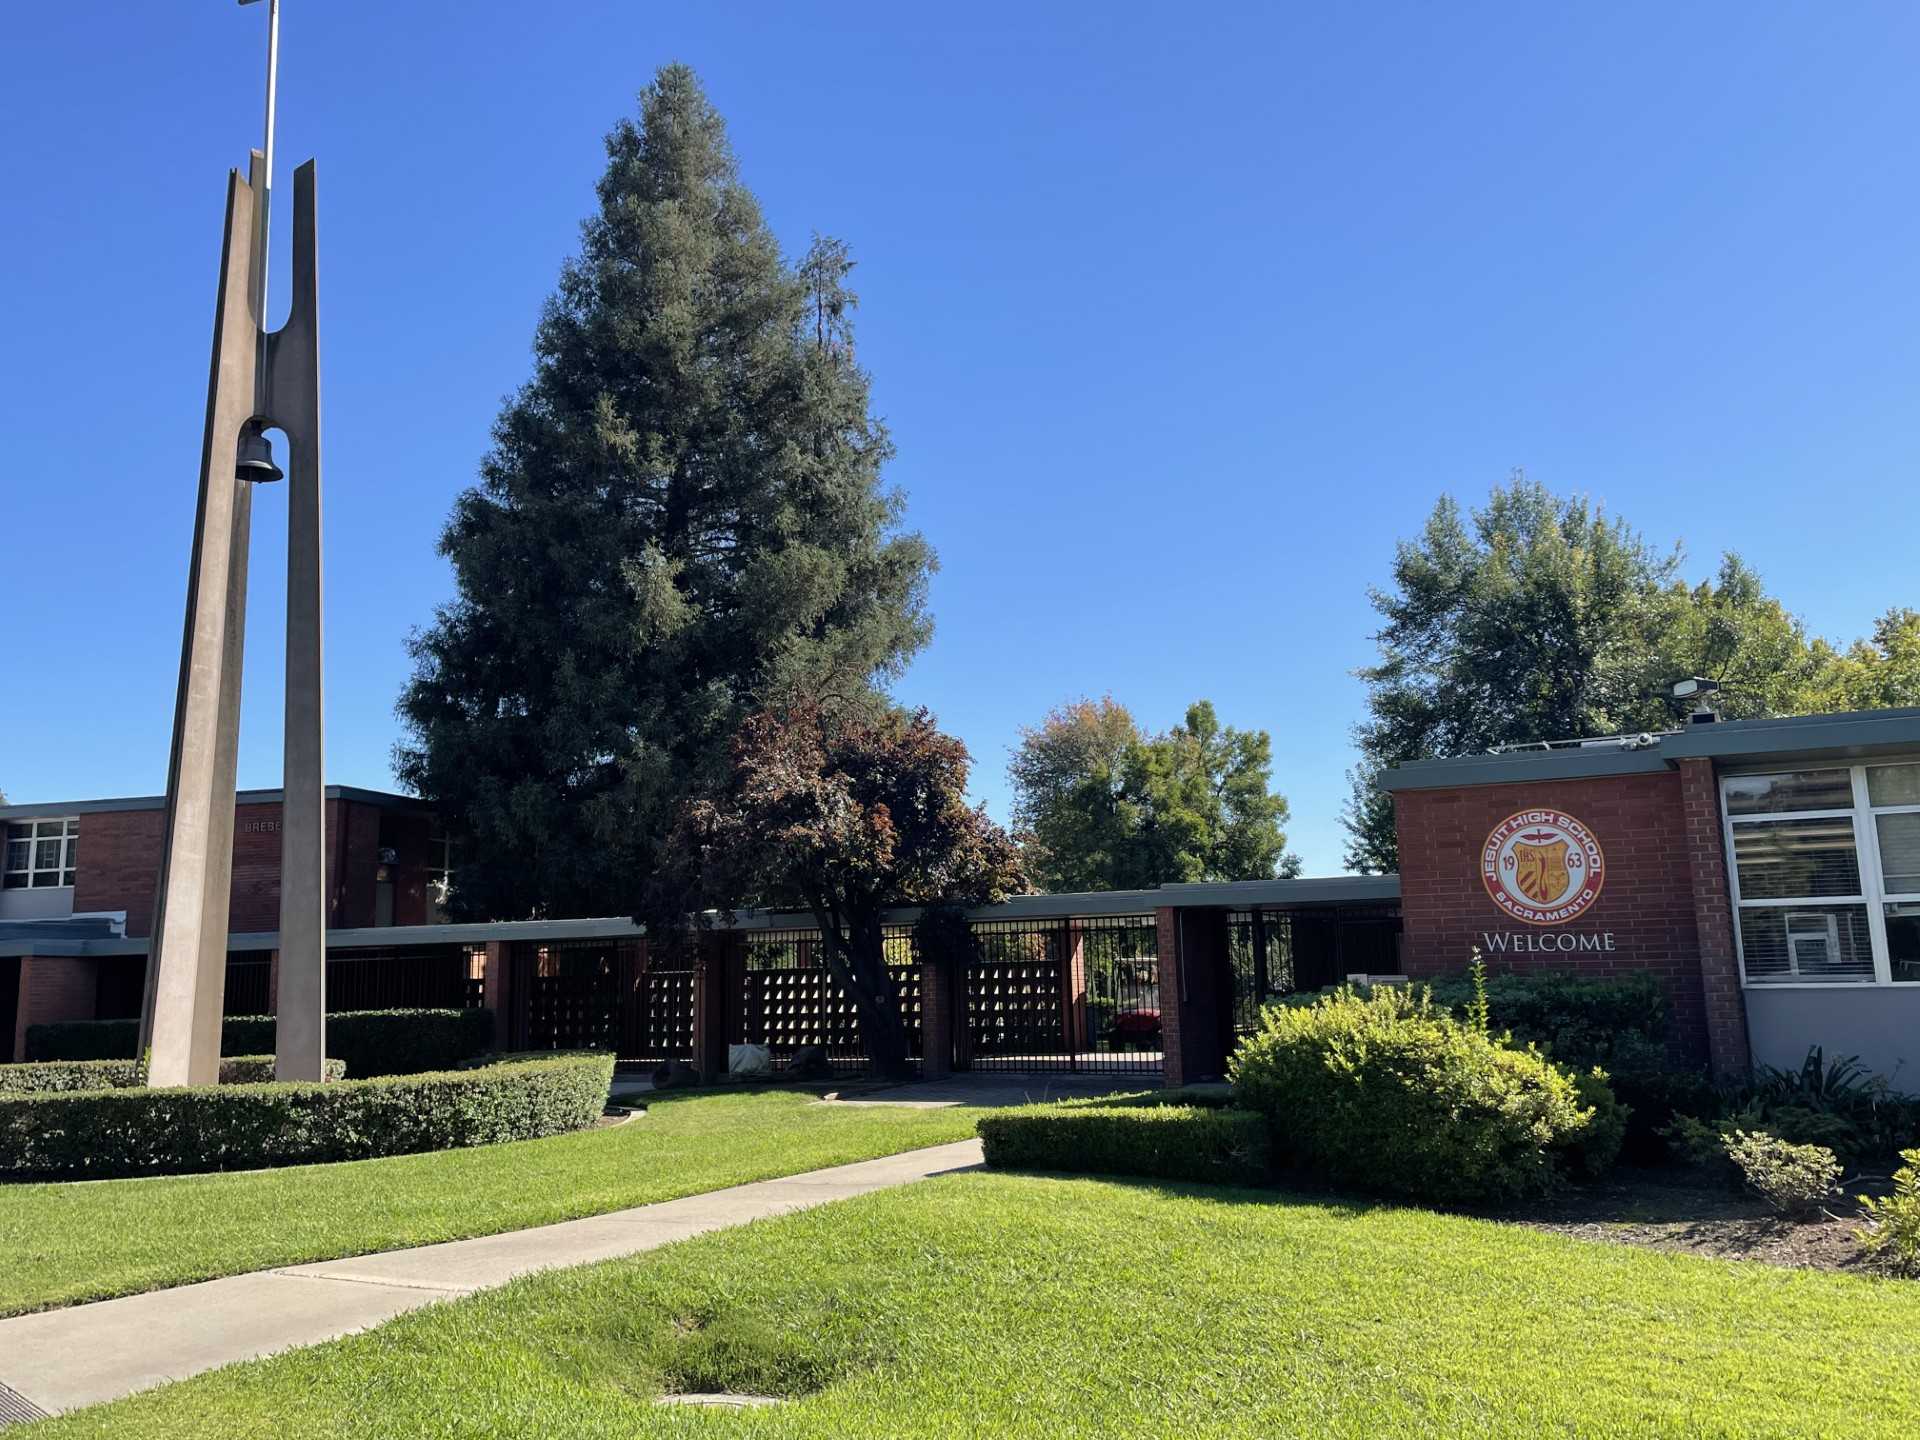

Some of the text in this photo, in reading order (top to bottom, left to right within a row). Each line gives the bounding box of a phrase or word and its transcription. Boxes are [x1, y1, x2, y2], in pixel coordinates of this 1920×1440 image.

[1485, 812, 1601, 881] JESUIT HIGH SCHOOL
[1503, 856, 1515, 871] 19
[1567, 852, 1582, 868] 63
[1496, 889, 1593, 921] SACRAMENTO
[1483, 932, 1616, 953] WELCOME
